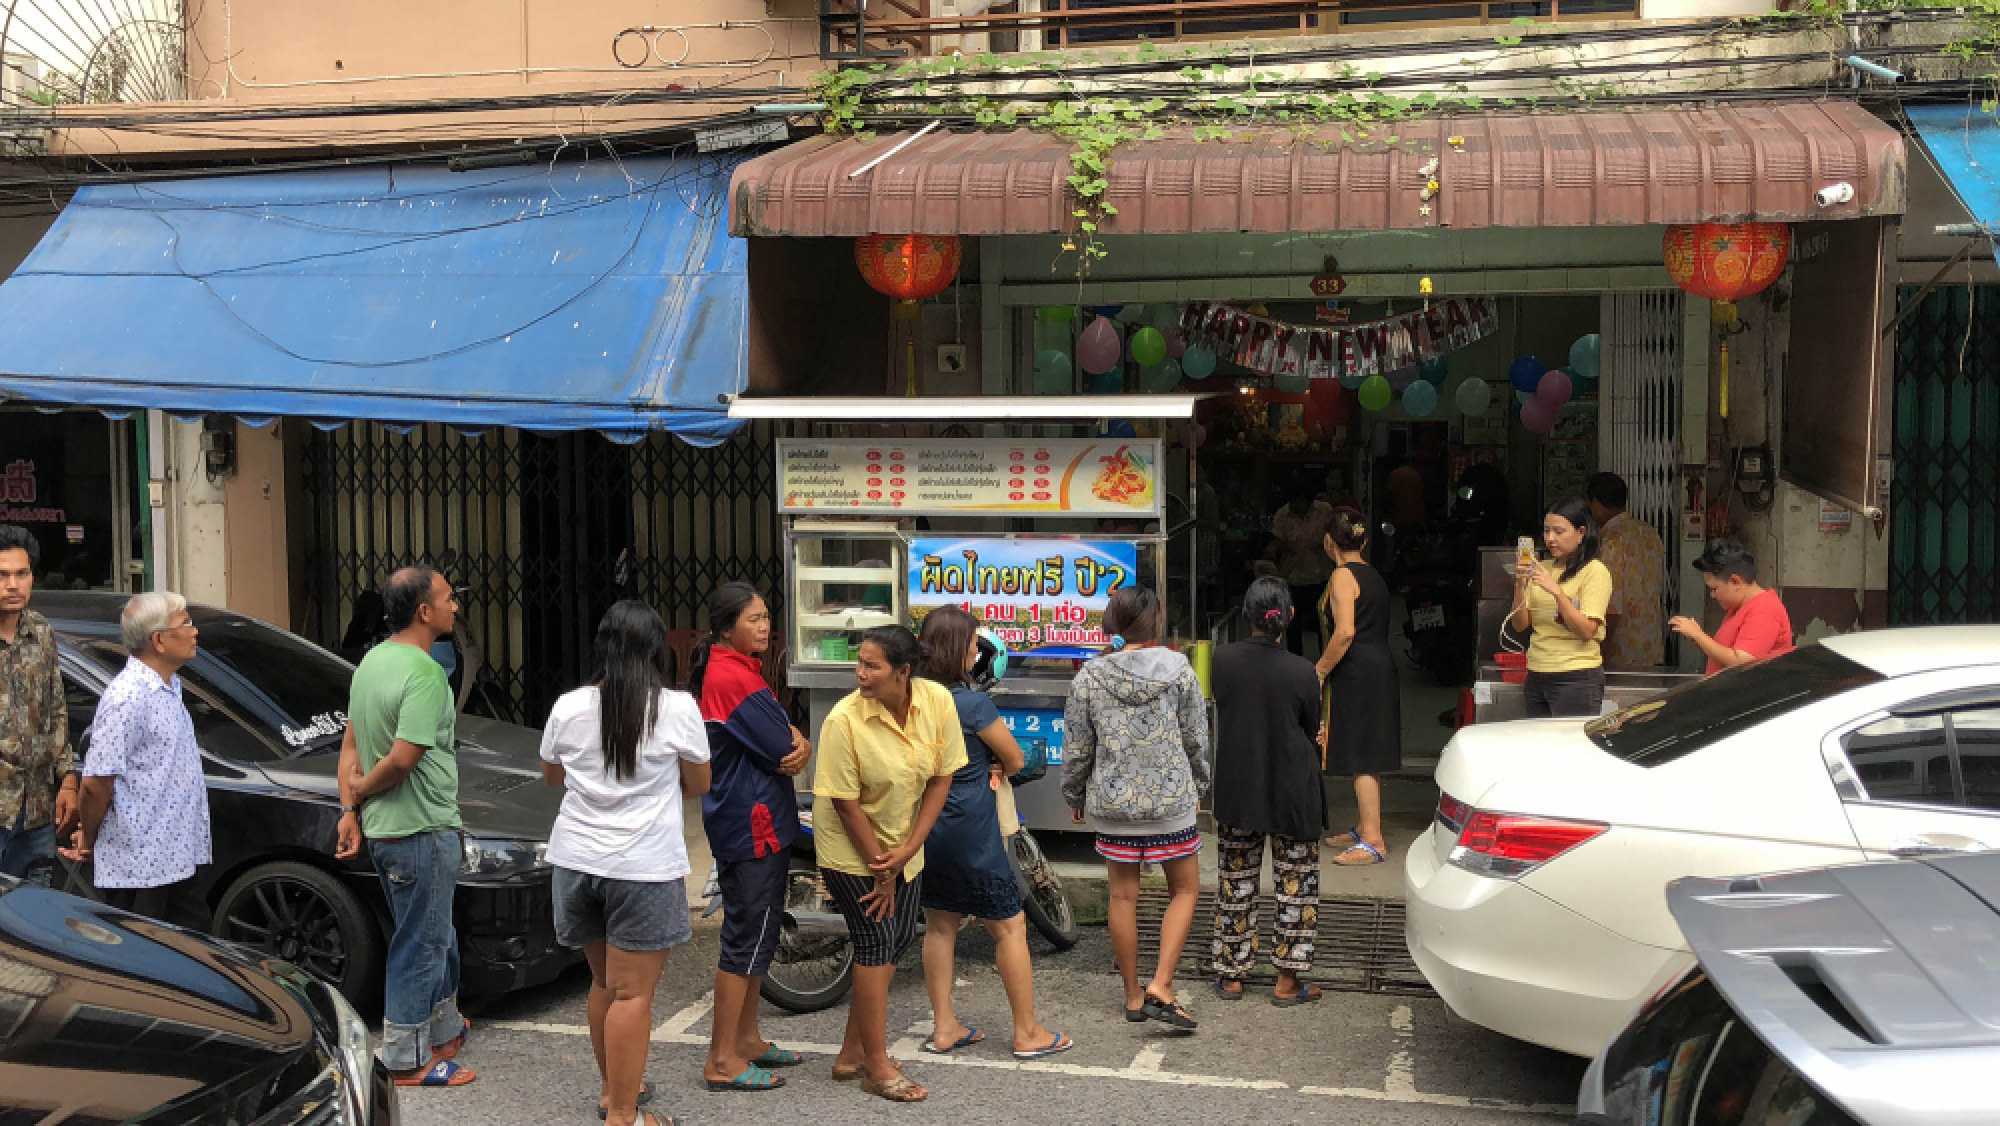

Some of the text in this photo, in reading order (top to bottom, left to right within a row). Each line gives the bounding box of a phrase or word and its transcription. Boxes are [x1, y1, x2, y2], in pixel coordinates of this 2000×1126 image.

[1184, 297, 1490, 361] HAPPY NEW YEAR
[920, 550, 1065, 597] ผัดไทยฟรี
[1027, 603, 1041, 622] 1
[1025, 715, 1041, 732] 2
